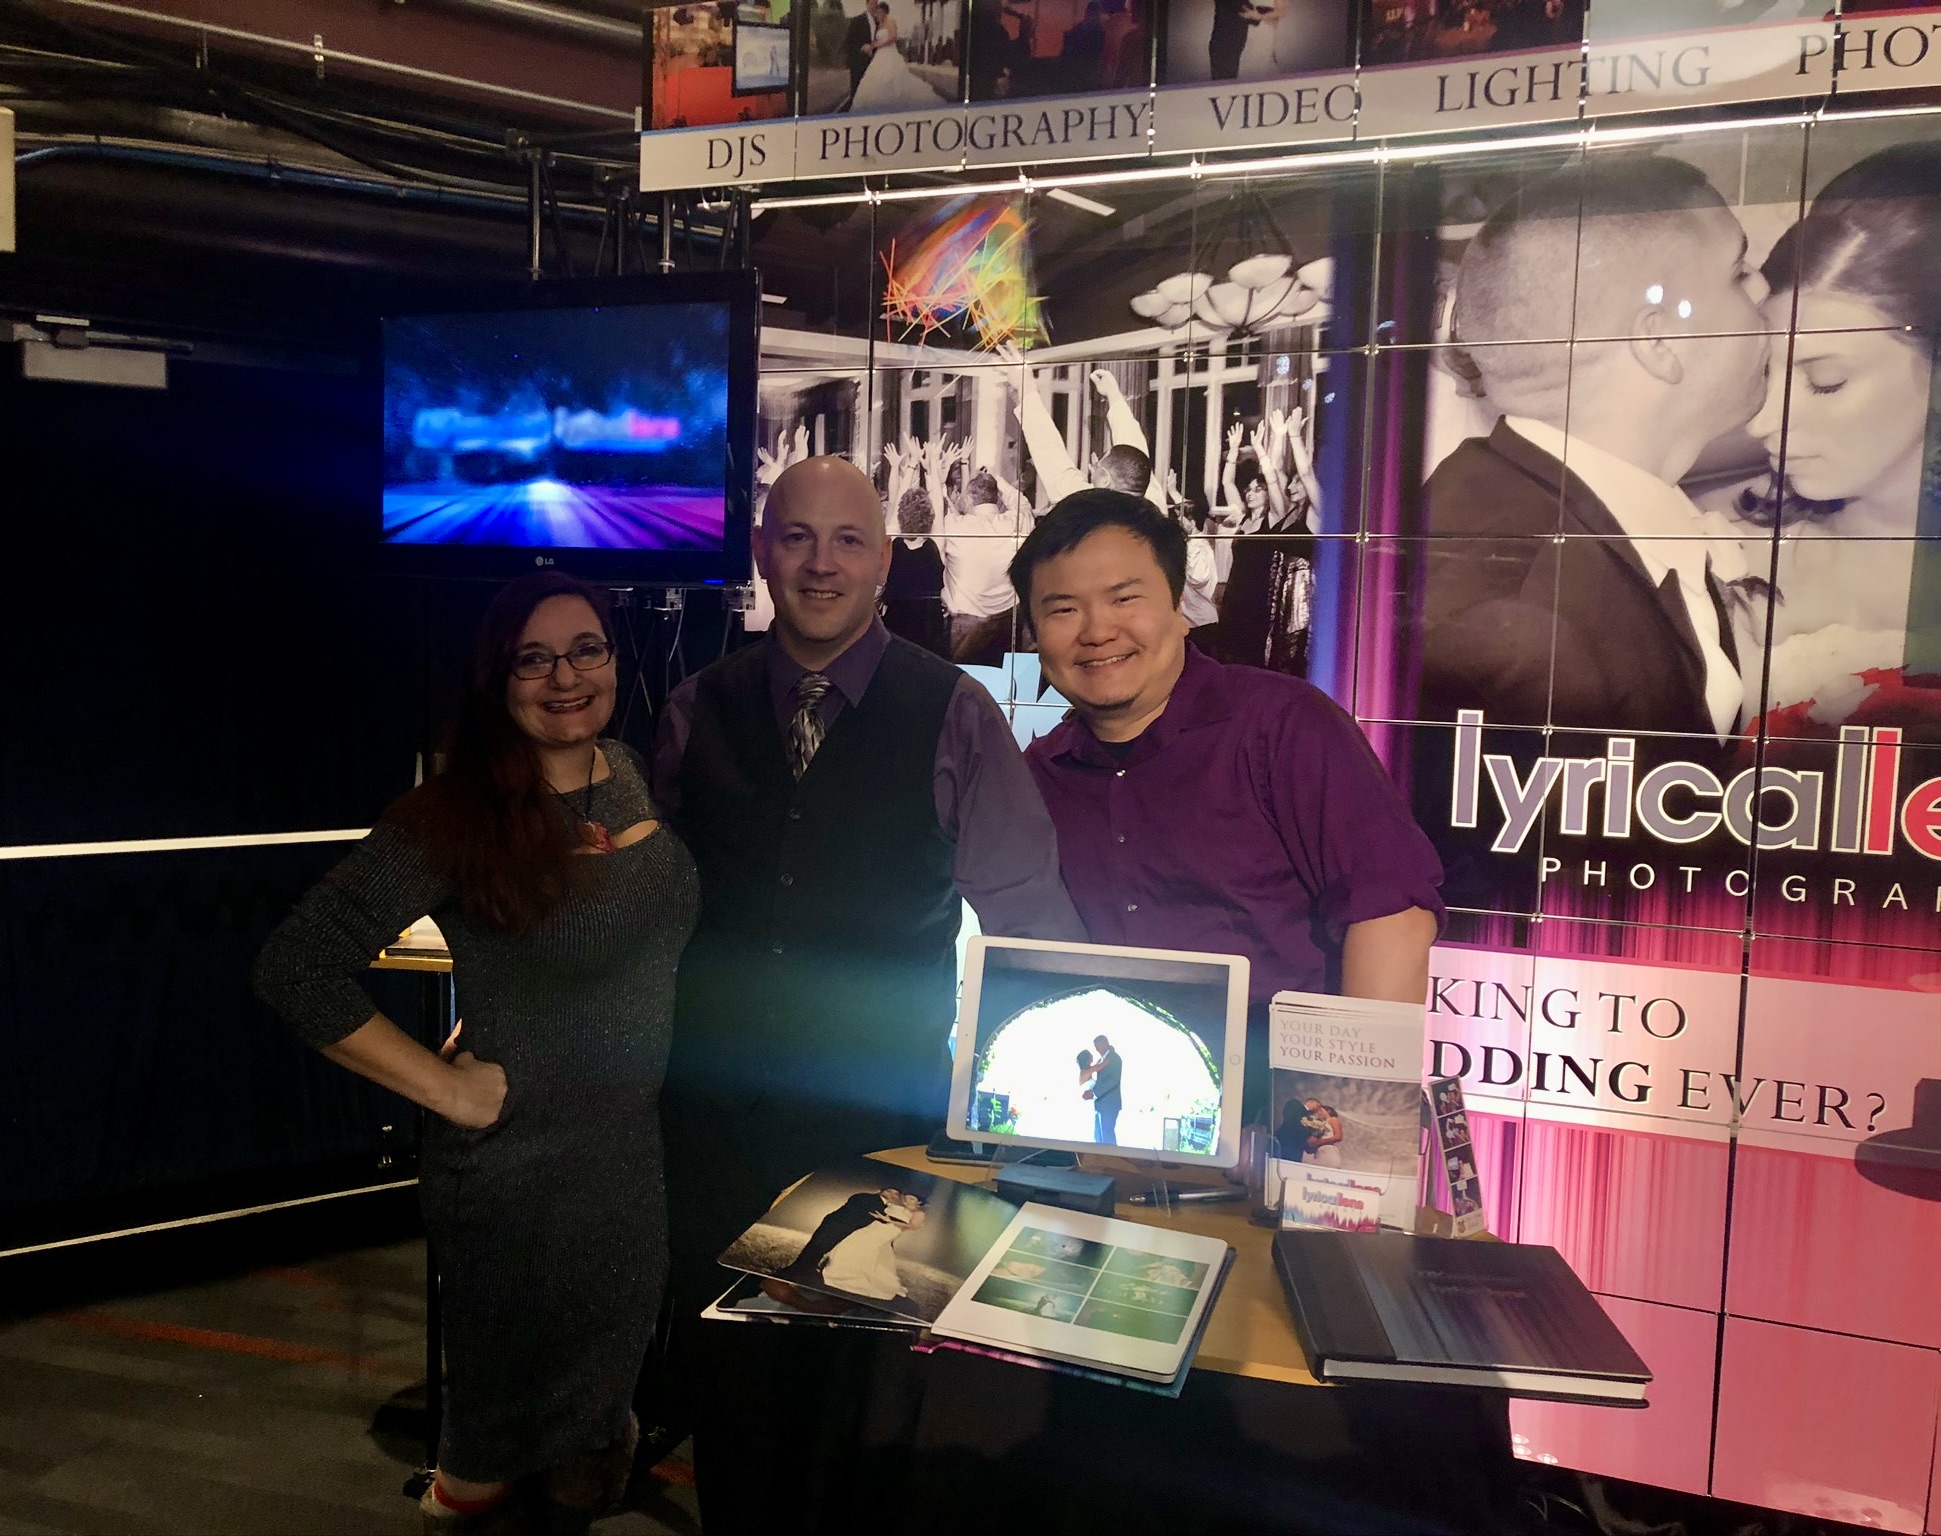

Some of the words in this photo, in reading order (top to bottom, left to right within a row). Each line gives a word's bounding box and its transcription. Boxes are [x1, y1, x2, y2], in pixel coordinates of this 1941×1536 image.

[706, 133, 767, 179] DJS
[819, 102, 1152, 160] PHOTOGRAPHY
[1207, 83, 1363, 131] VIDEO
[1436, 45, 1711, 112] LIGHTING
[1795, 24, 1941, 75] PHO
[1541, 856, 1941, 913] PHOTOGRA
[1280, 1019, 1324, 1035] YOUR
[1329, 1025, 1361, 1039] DAY
[1427, 976, 1582, 1030] KING
[1599, 991, 1687, 1039] TO
[1279, 1032, 1324, 1049] YOUR
[1329, 1038, 1376, 1054] STYLE
[1279, 1046, 1324, 1062] YOUR
[1329, 1052, 1396, 1069] PASSION
[1428, 1039, 1652, 1104] DDING
[1677, 1067, 1887, 1133] EVER?
